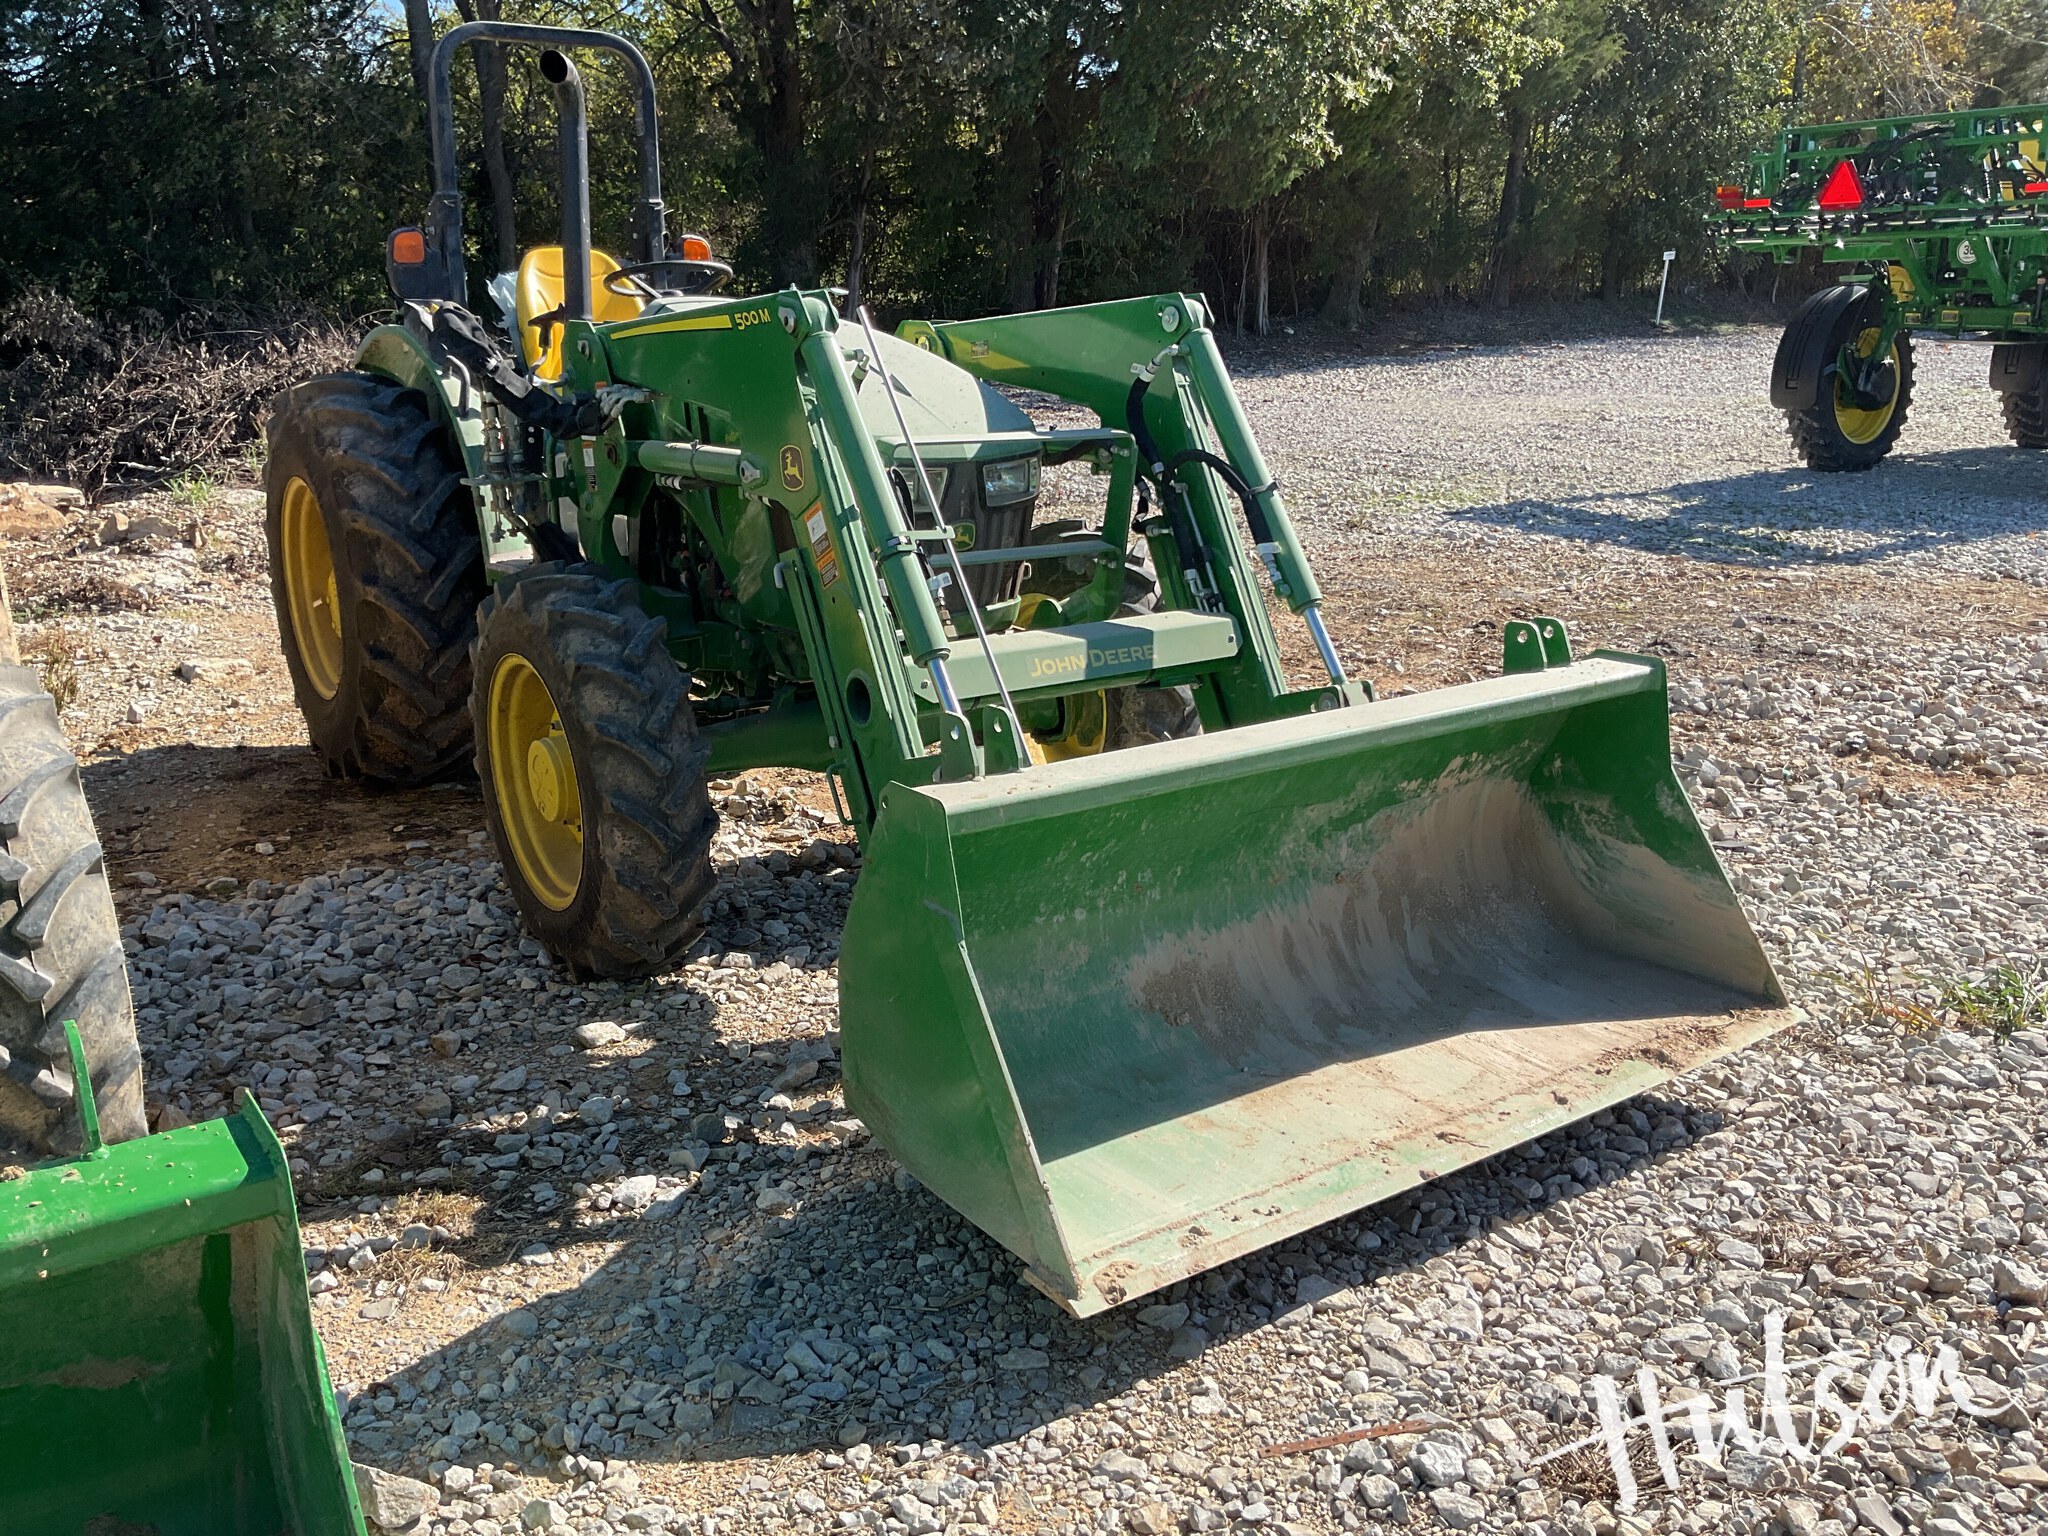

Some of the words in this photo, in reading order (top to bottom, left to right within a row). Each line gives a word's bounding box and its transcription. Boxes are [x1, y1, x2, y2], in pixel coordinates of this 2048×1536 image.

[734, 311, 759, 330] 500
[1031, 654, 1086, 678] JOHN
[1088, 644, 1157, 668] DEERE
